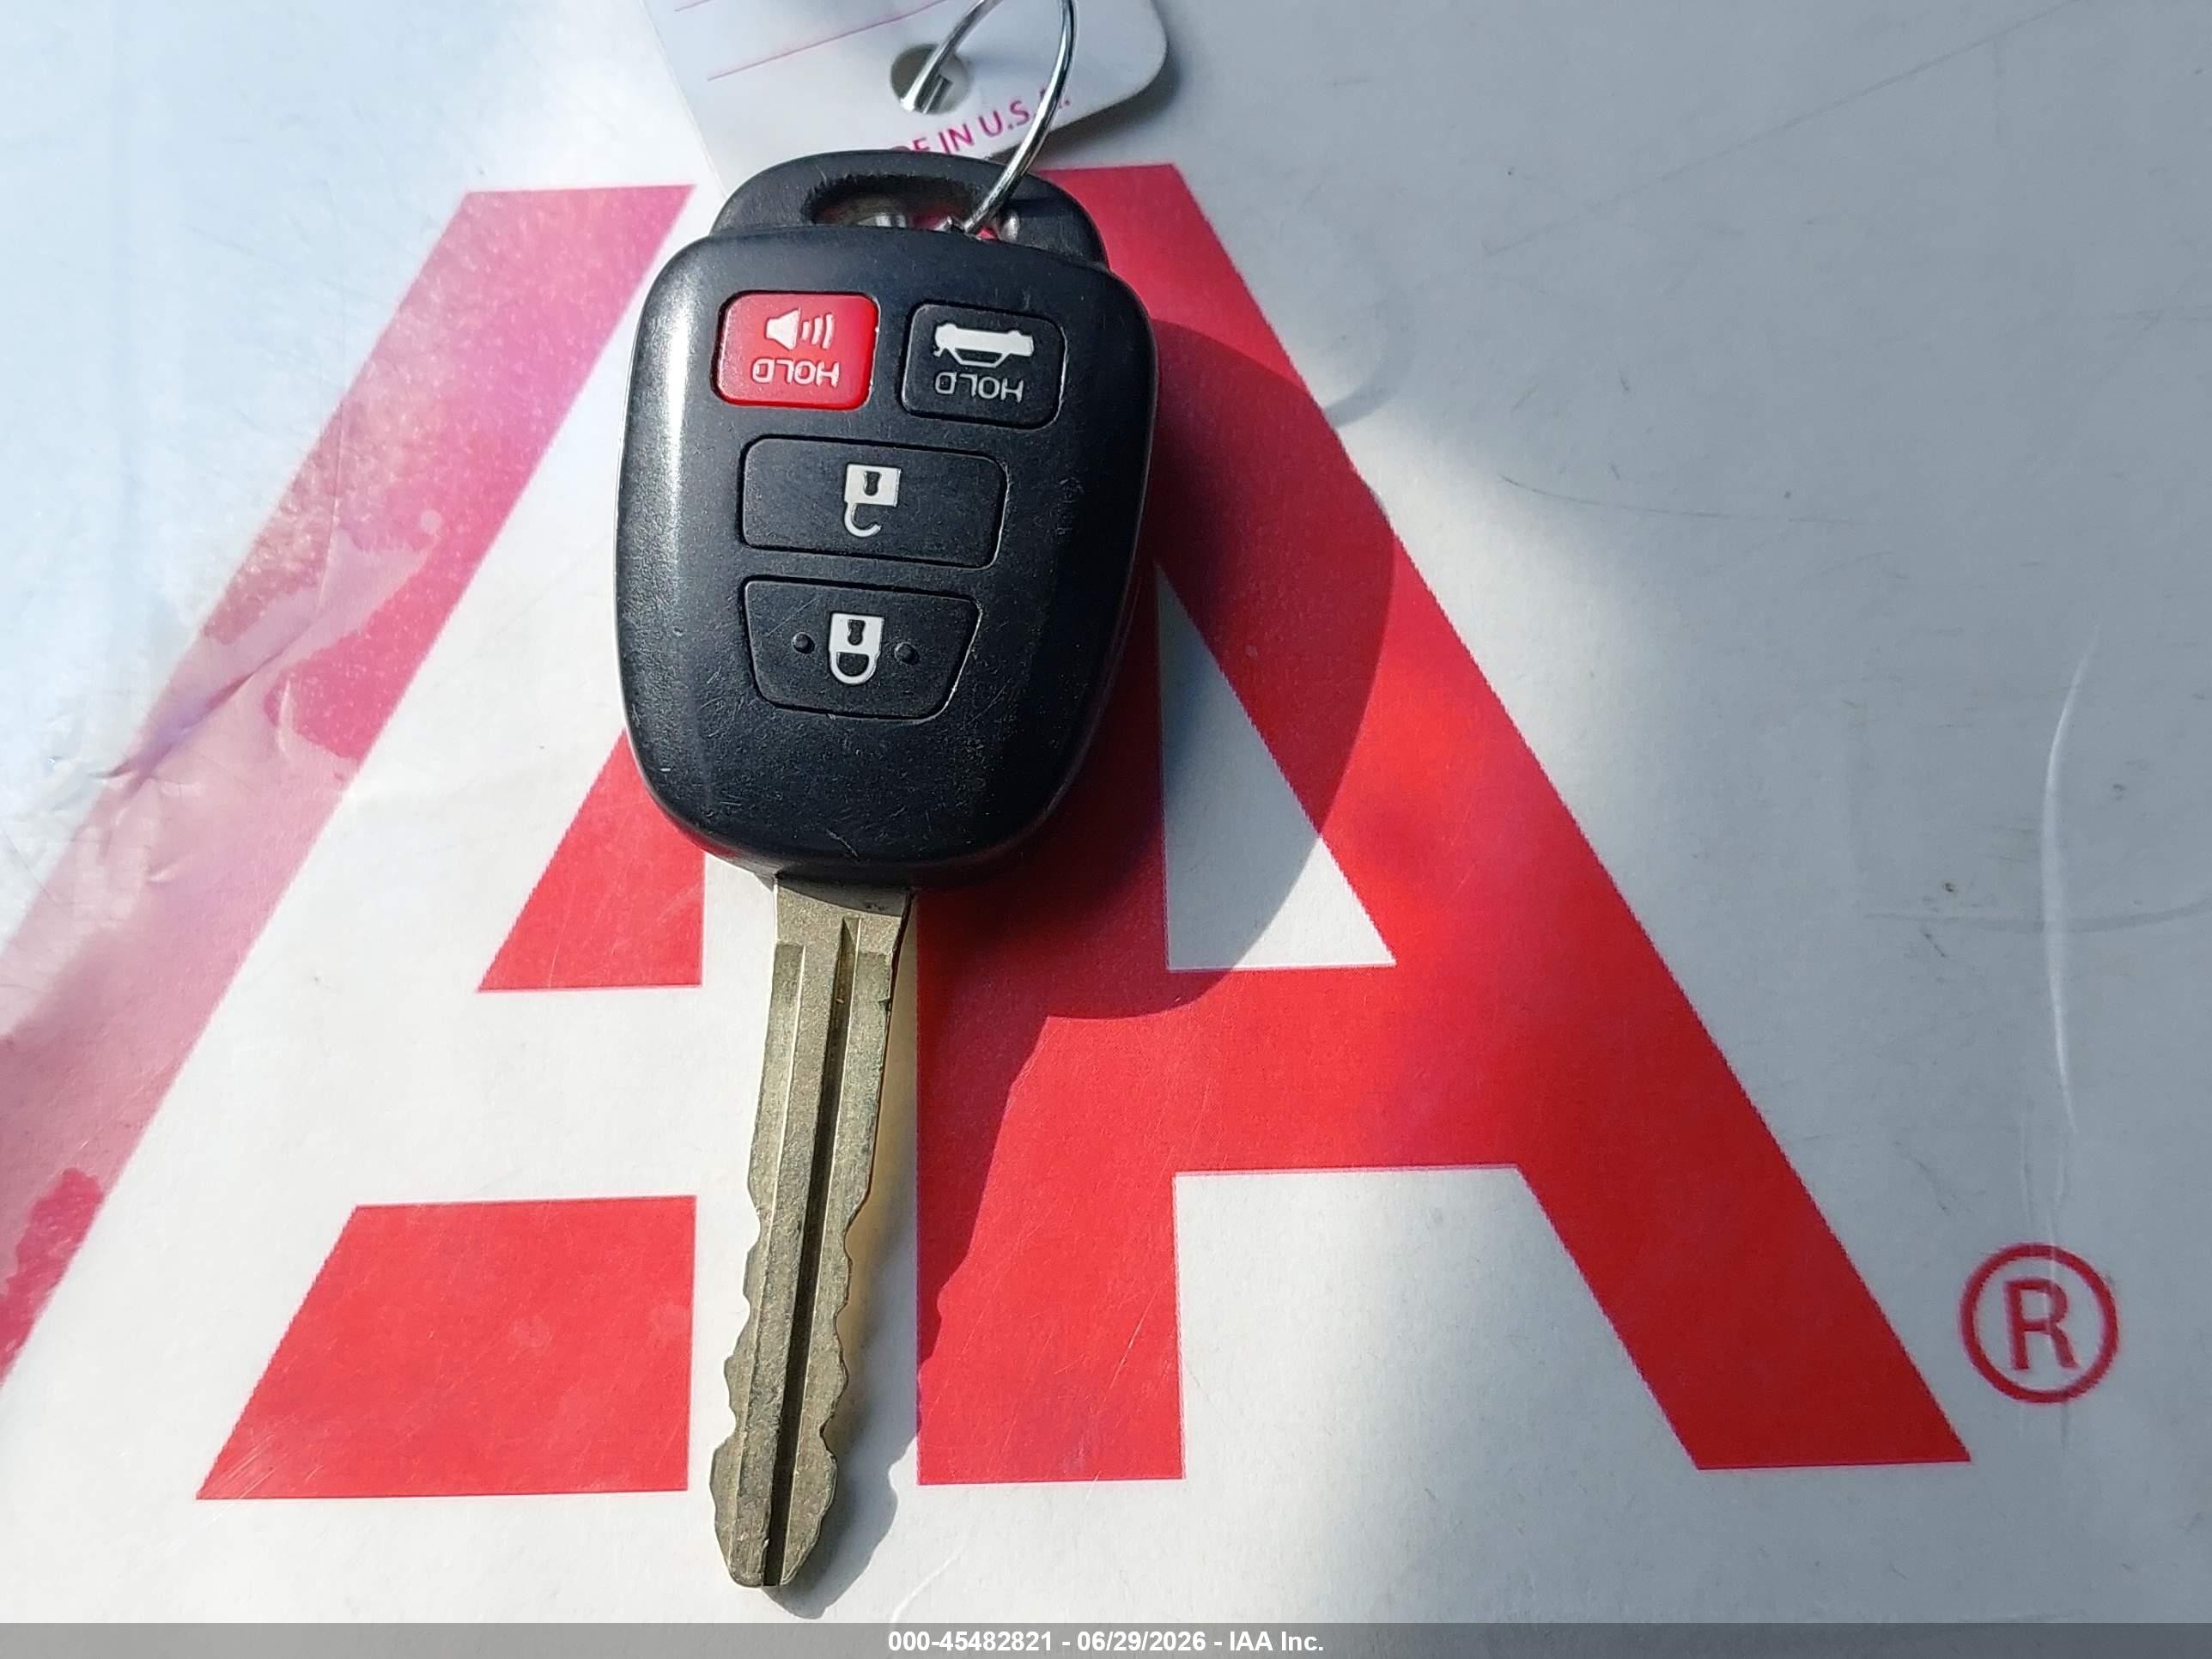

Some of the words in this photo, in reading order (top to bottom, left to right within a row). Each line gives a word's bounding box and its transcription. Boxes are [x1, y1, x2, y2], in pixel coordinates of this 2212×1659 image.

[939, 123, 975, 154] IN
[751, 358, 841, 387] HOLD
[934, 371, 1024, 403] HOLD
